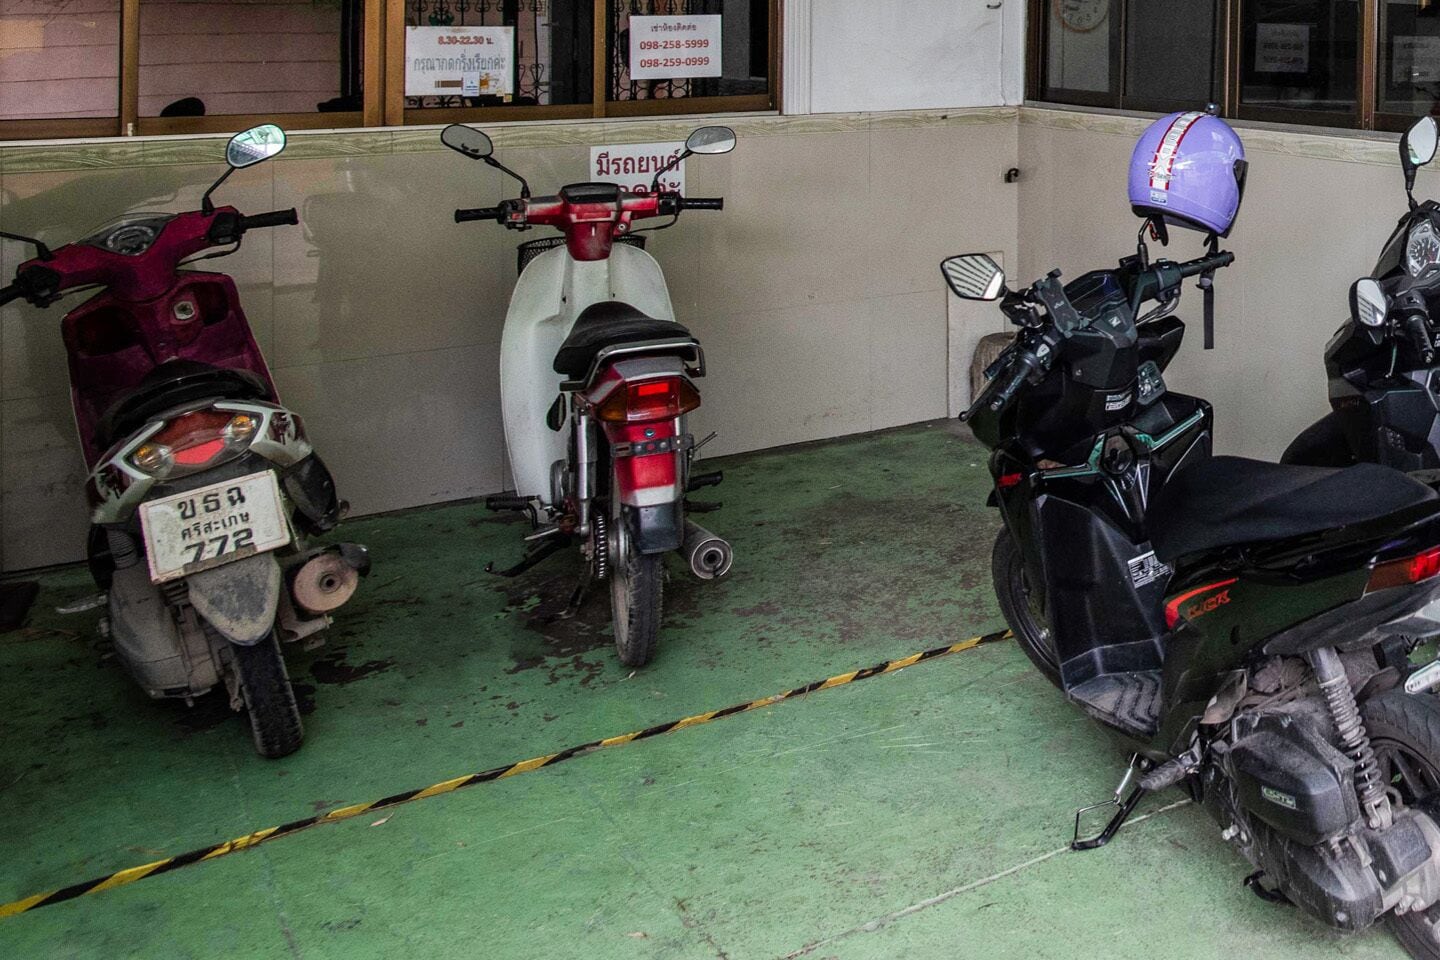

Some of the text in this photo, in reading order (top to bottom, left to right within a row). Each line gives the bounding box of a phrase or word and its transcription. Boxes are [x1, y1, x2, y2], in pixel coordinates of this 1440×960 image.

[640, 39, 709, 50] 098-258-5999
[640, 56, 710, 68] 098-259-0999
[596, 148, 681, 176] มีรถยนต์
[181, 528, 255, 562] 772
